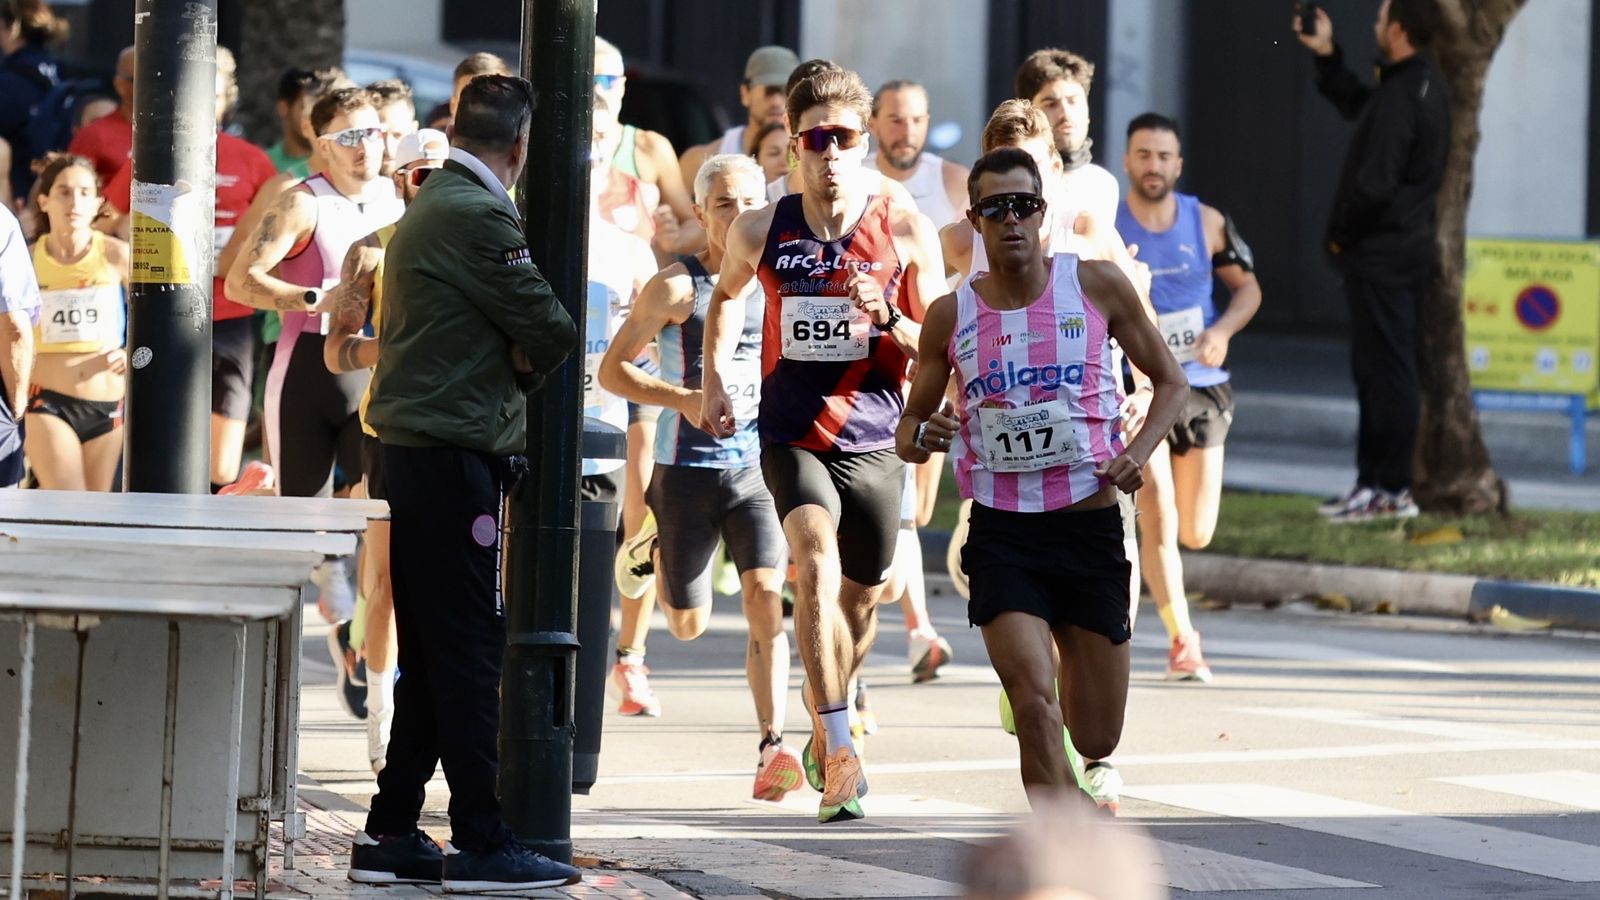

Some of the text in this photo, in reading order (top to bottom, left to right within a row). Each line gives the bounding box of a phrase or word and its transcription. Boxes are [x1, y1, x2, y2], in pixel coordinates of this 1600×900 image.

[779, 240, 800, 249] SPORT
[776, 254, 816, 270] RFC
[52, 308, 97, 326] 409
[793, 320, 851, 341] 694
[1167, 330, 1195, 348] 48
[726, 384, 755, 400] 24
[996, 427, 1053, 453] 117
